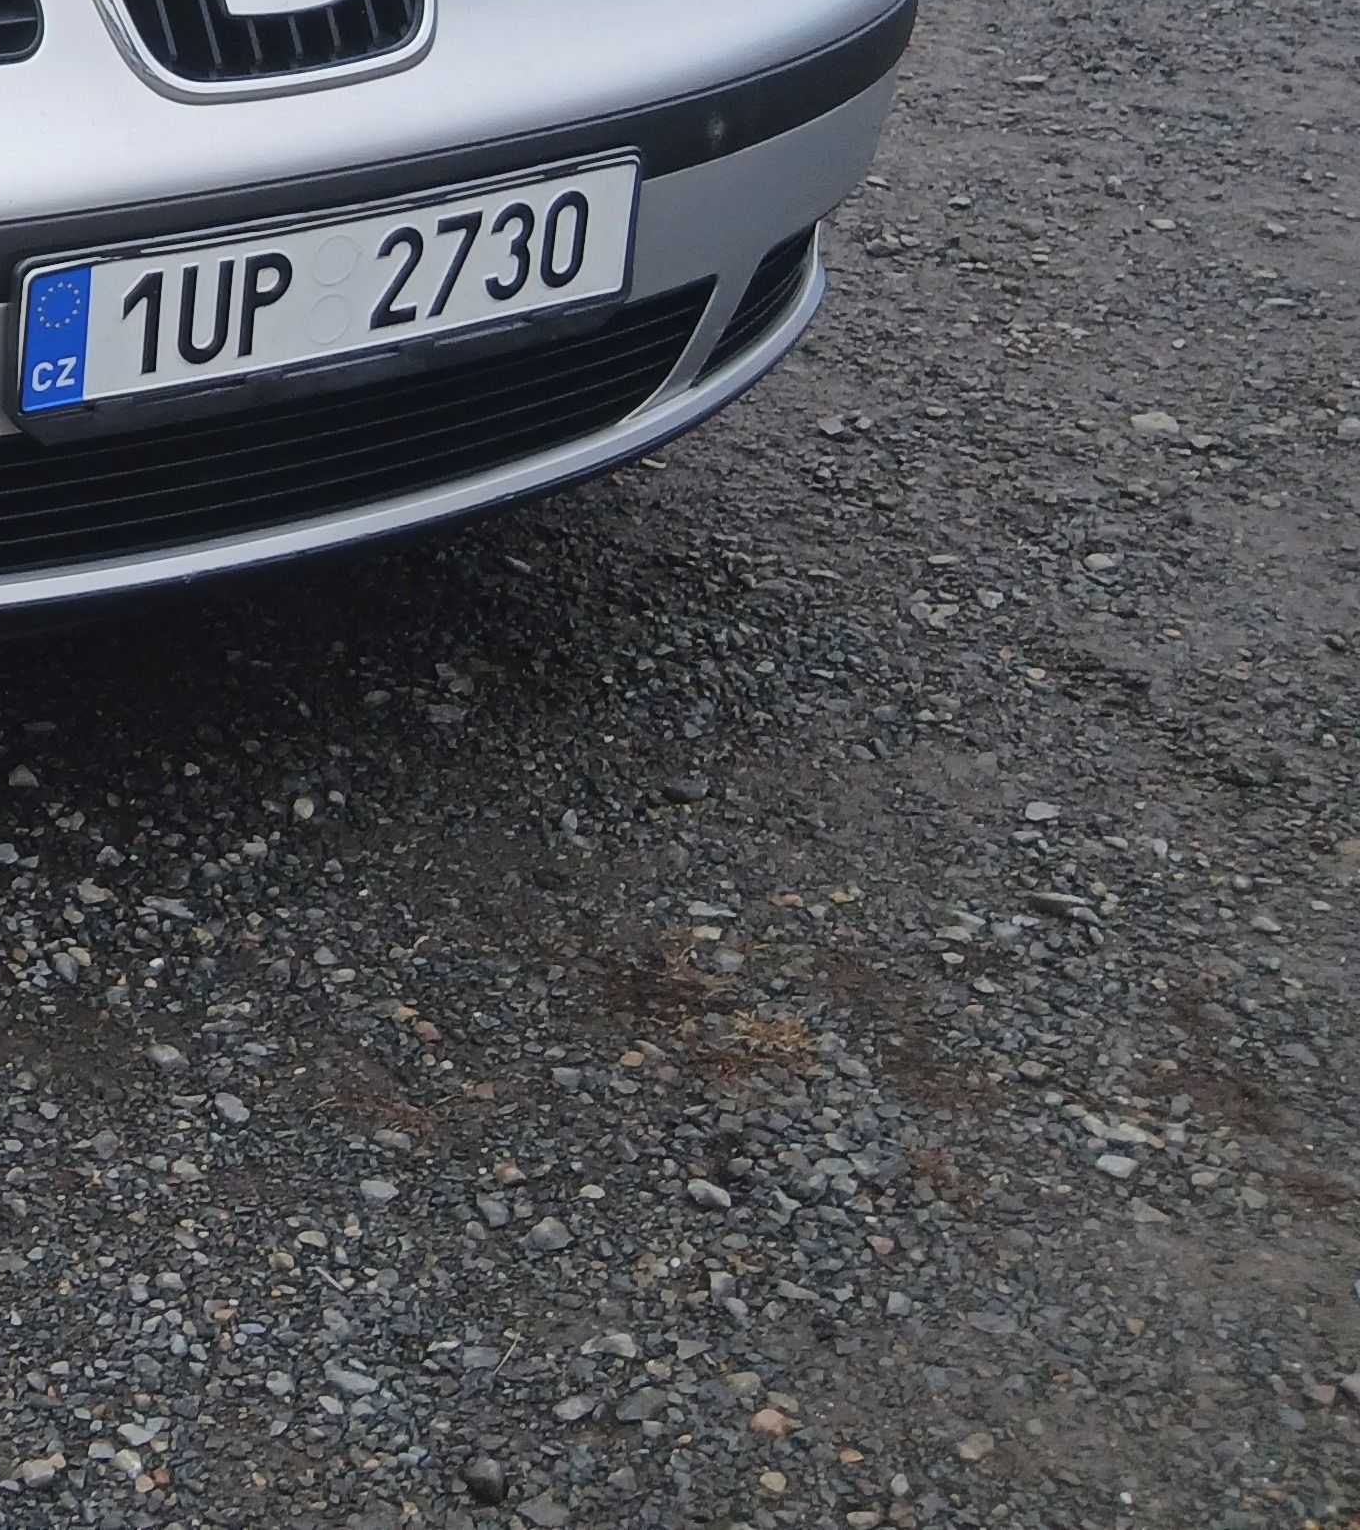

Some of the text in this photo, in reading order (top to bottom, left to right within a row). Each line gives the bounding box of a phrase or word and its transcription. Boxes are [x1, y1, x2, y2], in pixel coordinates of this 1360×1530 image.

[121, 189, 589, 375] 1UP 2730
[31, 356, 77, 392] CZ
